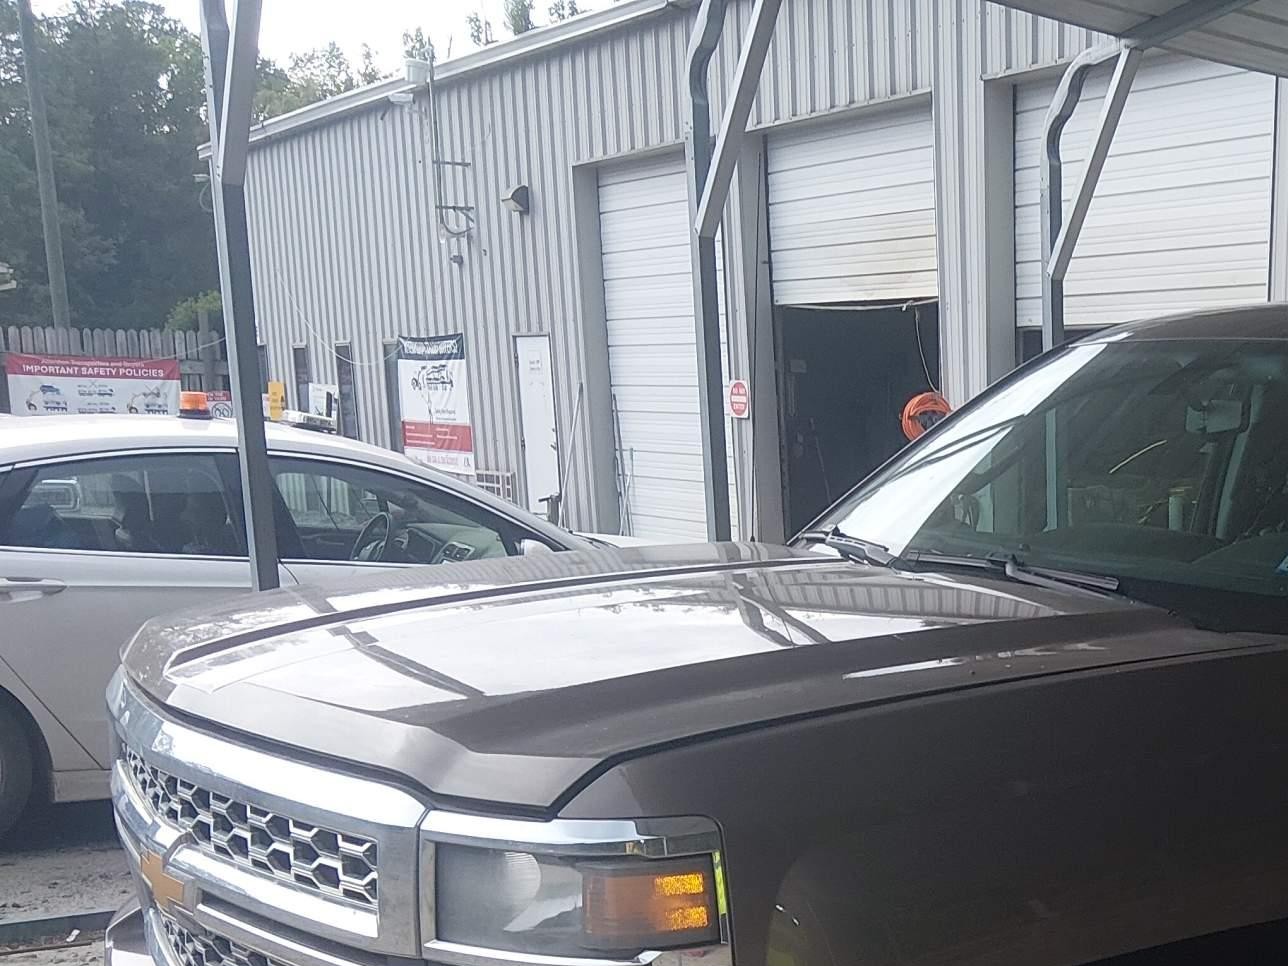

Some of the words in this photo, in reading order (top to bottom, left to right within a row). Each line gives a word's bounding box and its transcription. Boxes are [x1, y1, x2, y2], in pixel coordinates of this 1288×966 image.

[22, 363, 79, 375] IMPORTANT
[81, 366, 117, 376] SAFETY
[119, 368, 164, 377] POLICIES
